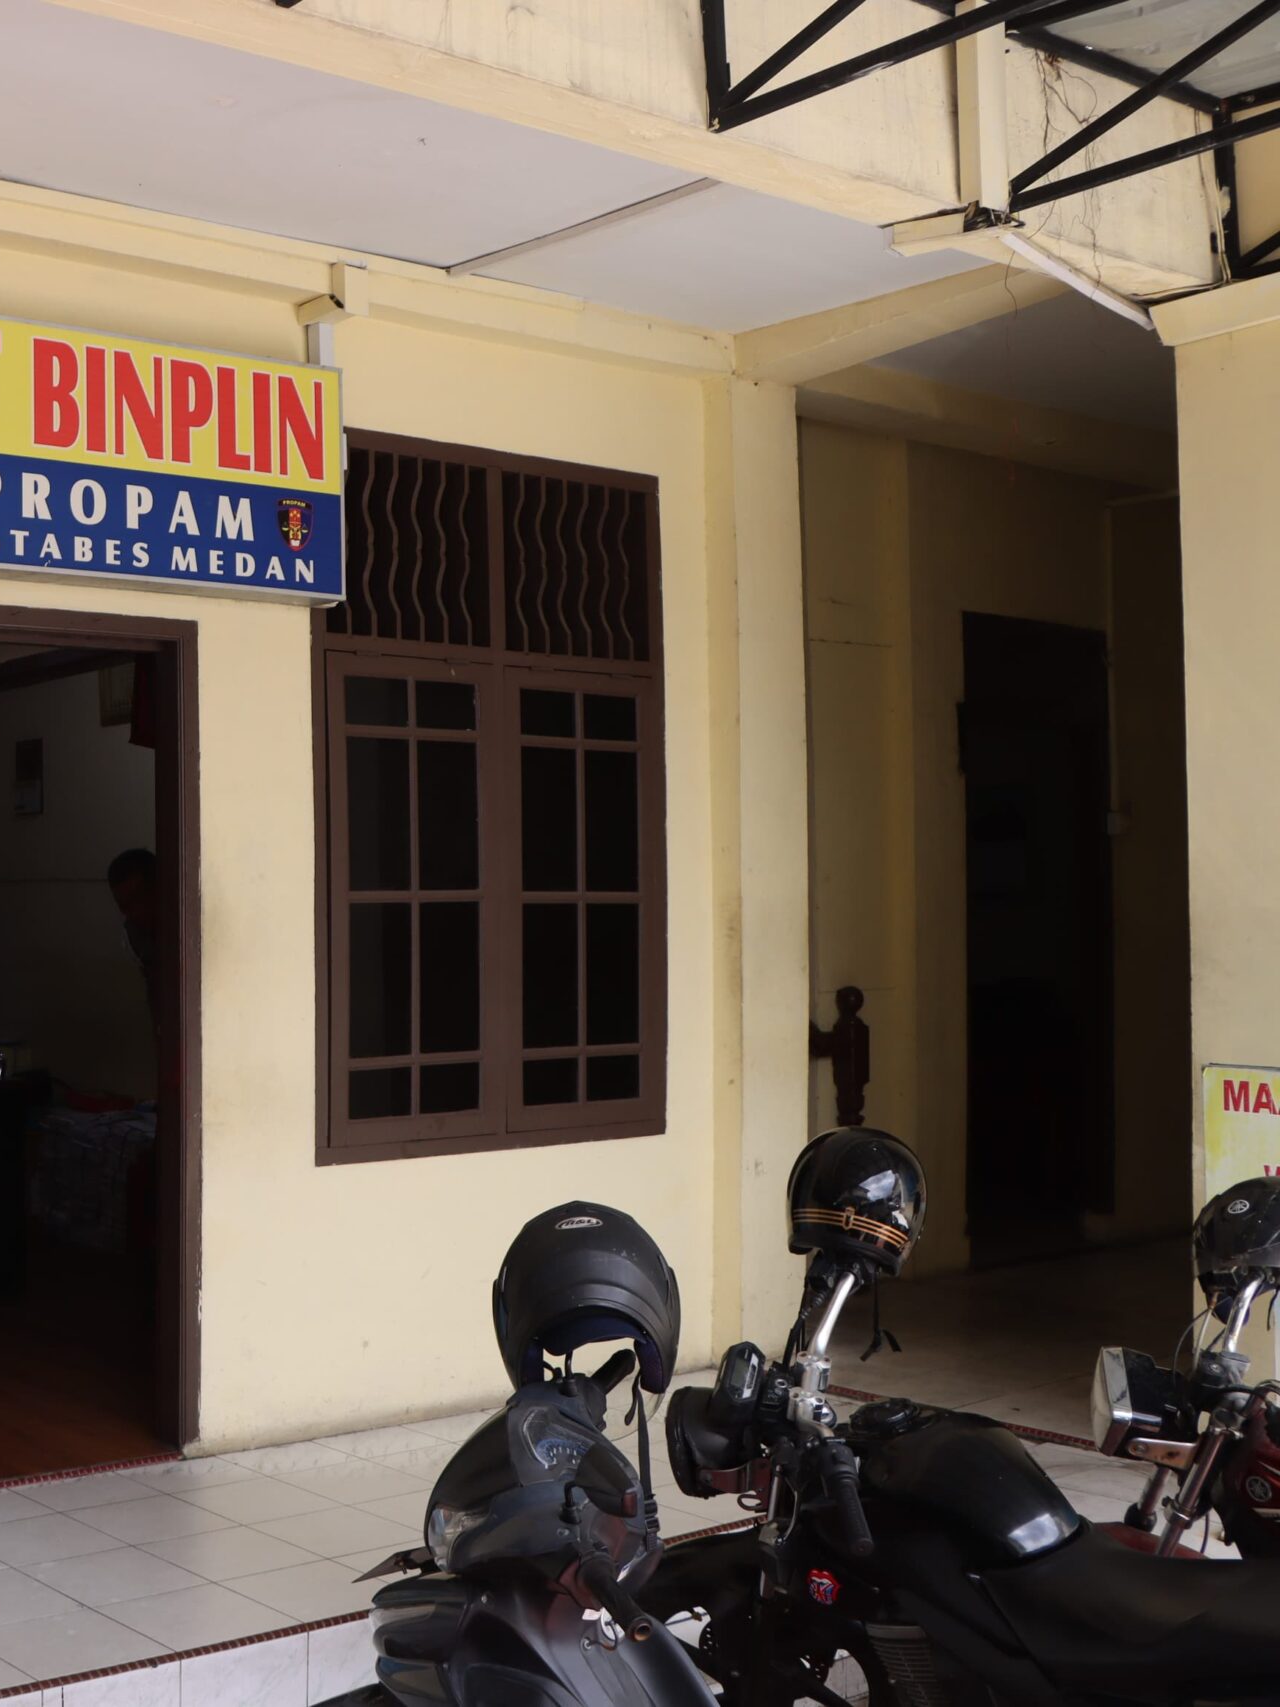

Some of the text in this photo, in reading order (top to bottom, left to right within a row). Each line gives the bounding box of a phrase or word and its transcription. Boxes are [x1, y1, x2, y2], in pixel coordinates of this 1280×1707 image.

[33, 337, 324, 481] BINPLIN
[282, 498, 307, 509] PROPAM
[170, 546, 315, 584] MEDAN
[1222, 1078, 1280, 1115] MA
